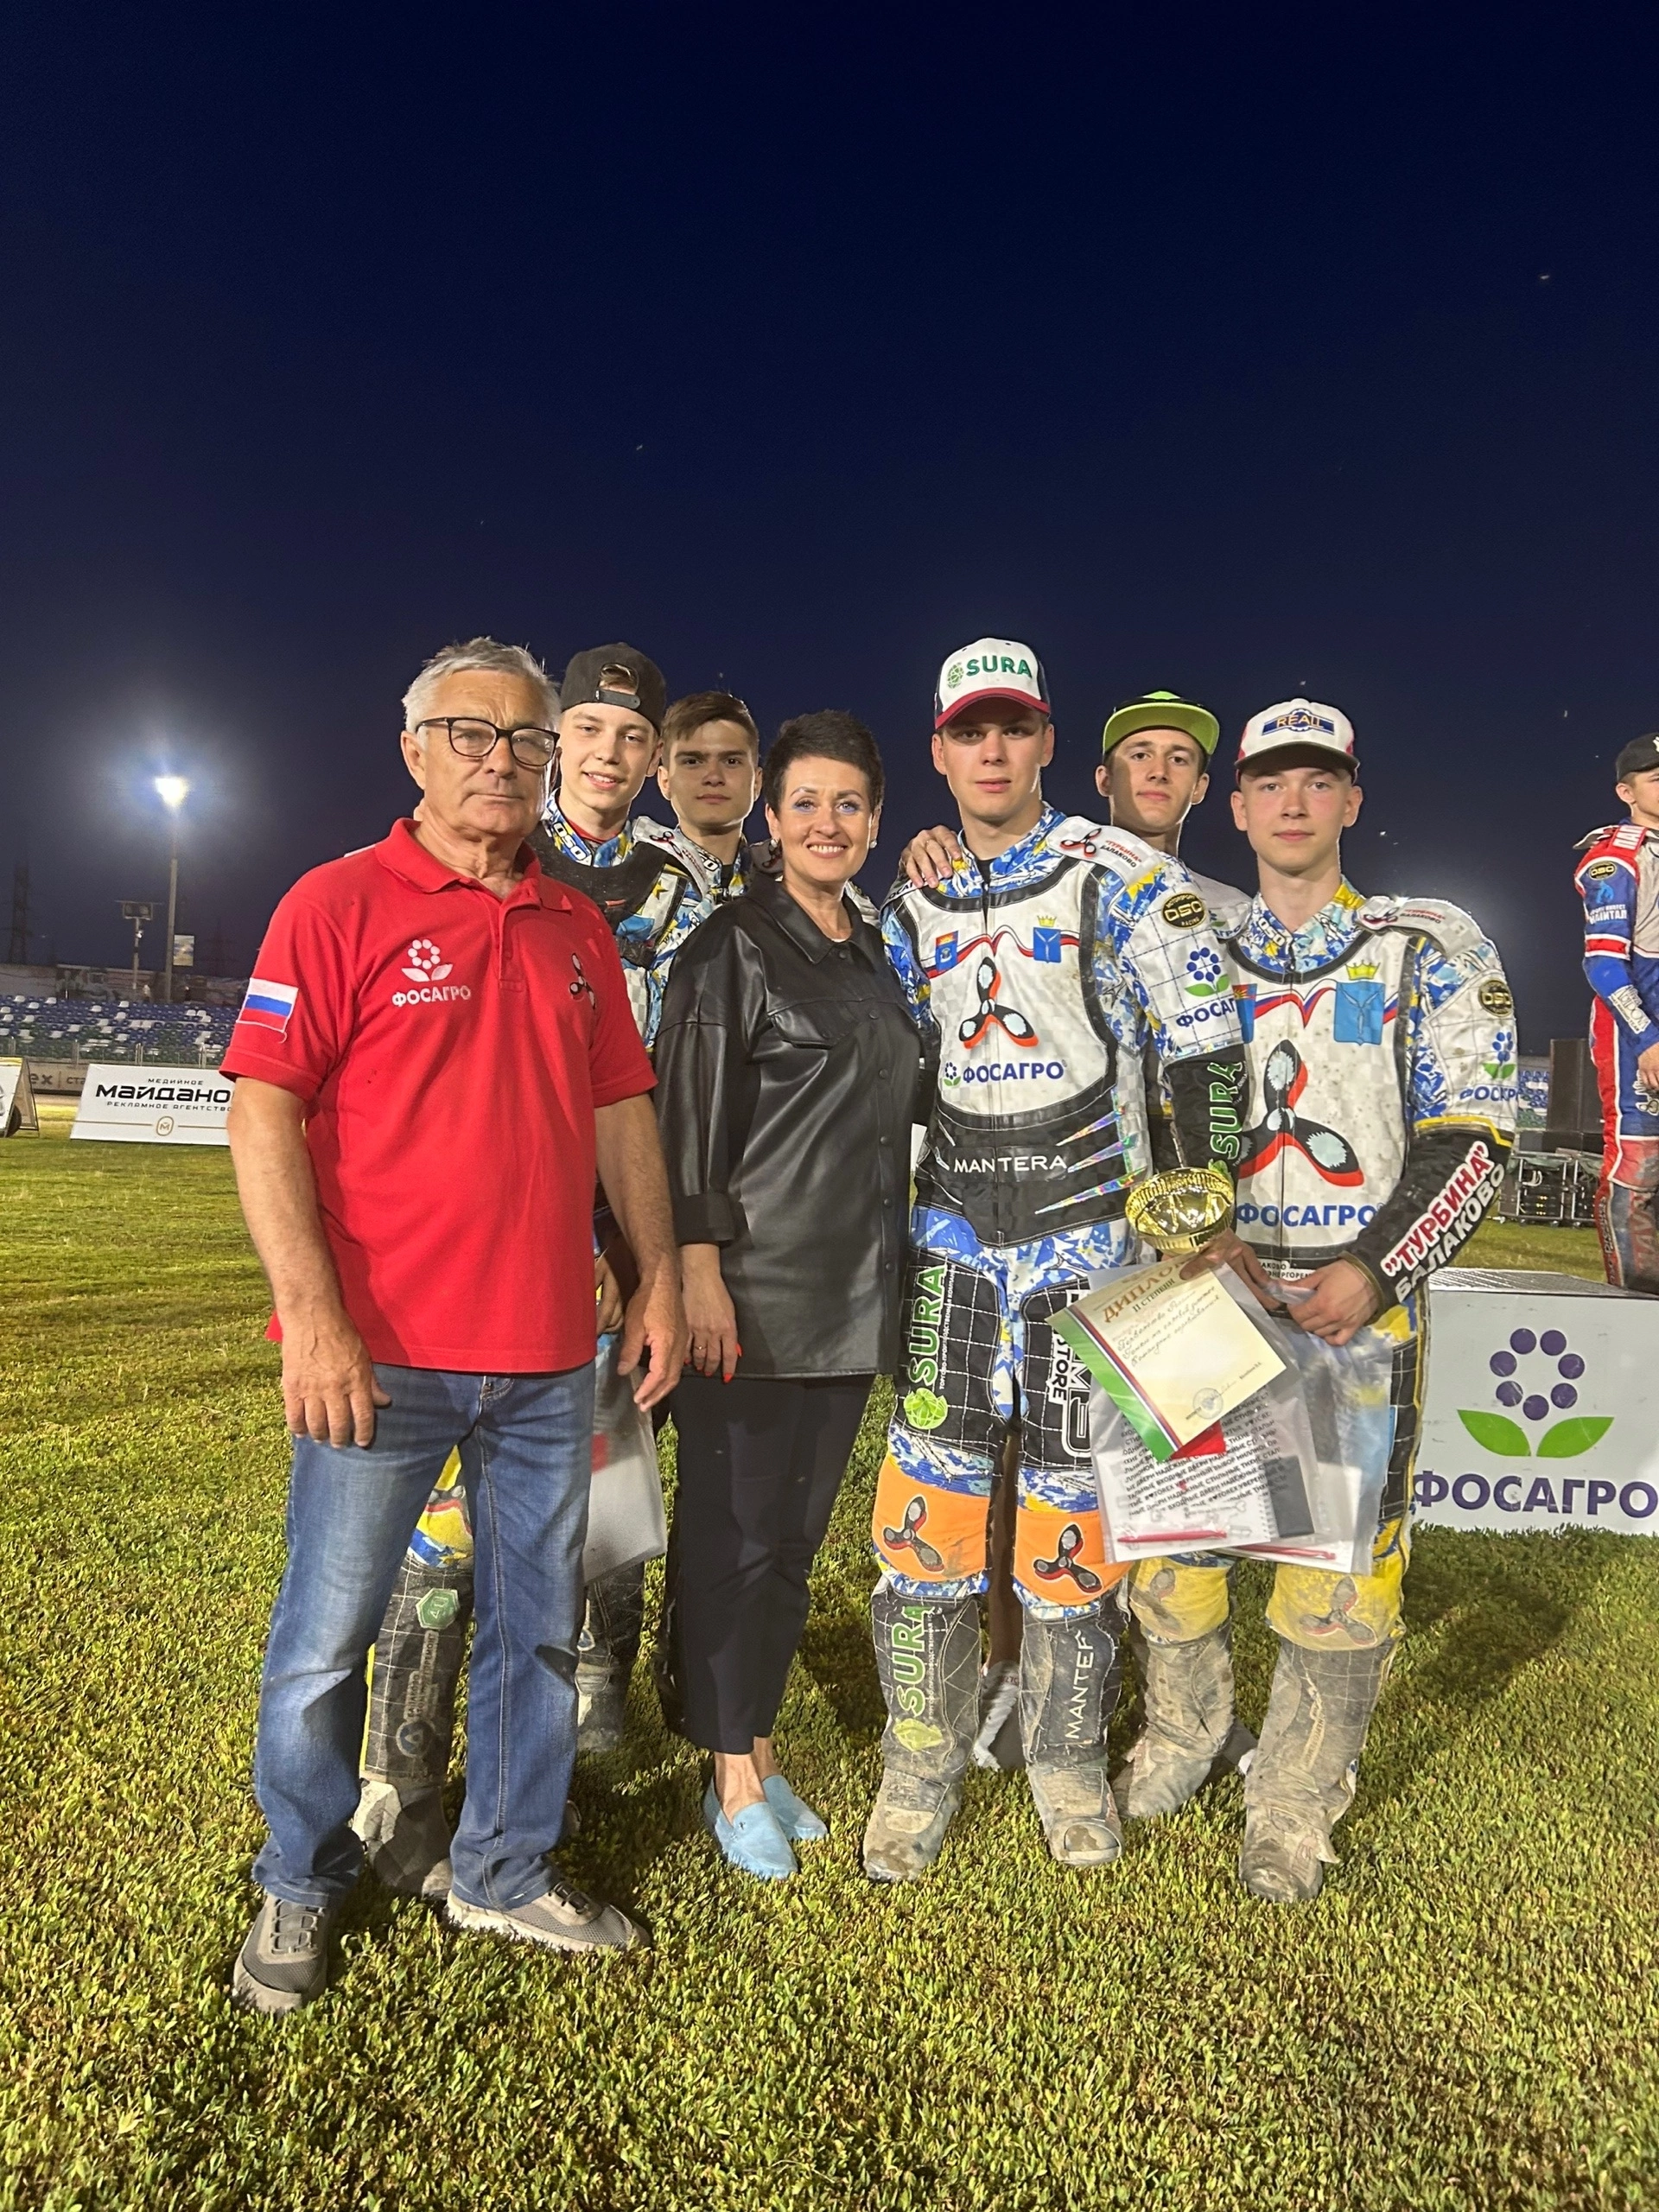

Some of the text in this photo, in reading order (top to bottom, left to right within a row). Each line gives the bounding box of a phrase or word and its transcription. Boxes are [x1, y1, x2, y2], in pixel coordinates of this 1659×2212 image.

[966, 655, 1033, 678] SURA
[1100, 845, 1137, 868] БАЛАКОВО
[392, 985, 472, 1007] ФОСАГРО
[1176, 998, 1236, 1027] ФОСАГ
[148, 1077, 204, 1086] МЕДИЙНОЕ
[963, 1062, 1065, 1084] ФОСАГРО
[95, 1084, 234, 1103] МАЙДАНО
[106, 1101, 168, 1109] РЕКЛАМНОЕ
[1207, 1062, 1243, 1160] SURA
[954, 1154, 1068, 1173] MANTERA
[1236, 1203, 1378, 1229] ФОСАГРО
[1395, 1164, 1505, 1303] БАЛАКОВО
[1141, 1278, 1175, 1307] СТЕПЕНИ
[909, 1263, 948, 1385] SURA
[1128, 1483, 1155, 1500] ТАЛЬНЫЕ
[1413, 1471, 1658, 1518] ФОСАГРО
